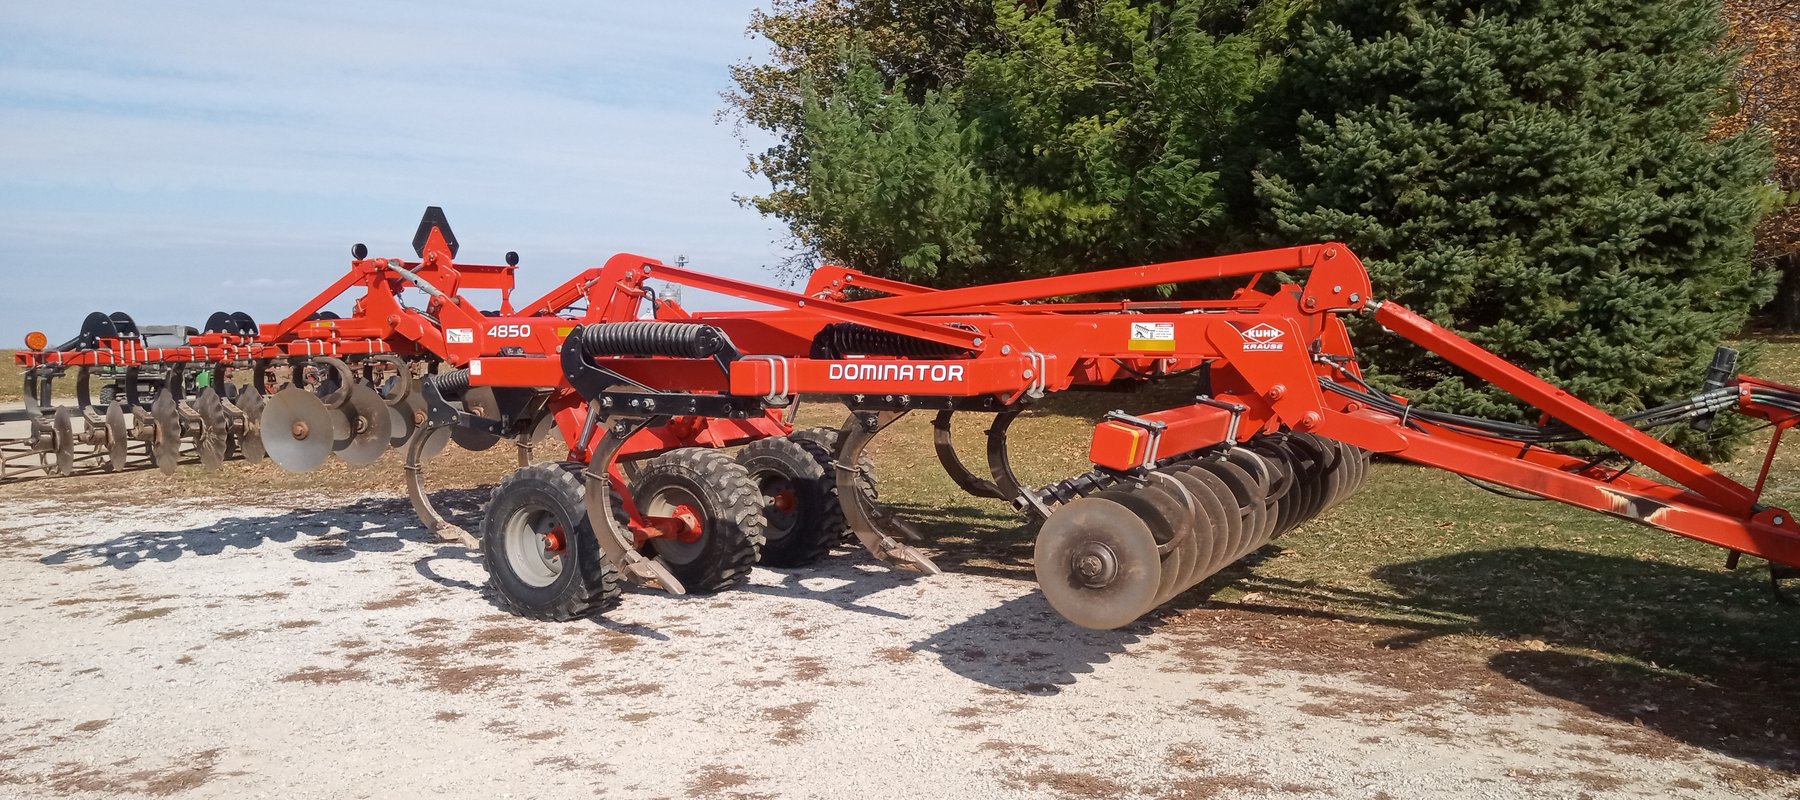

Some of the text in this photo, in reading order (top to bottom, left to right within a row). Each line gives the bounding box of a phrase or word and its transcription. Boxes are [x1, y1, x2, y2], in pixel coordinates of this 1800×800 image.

[487, 324, 531, 338] 4850
[1248, 329, 1279, 338] KUHN
[829, 363, 964, 381] DOMINATOR
